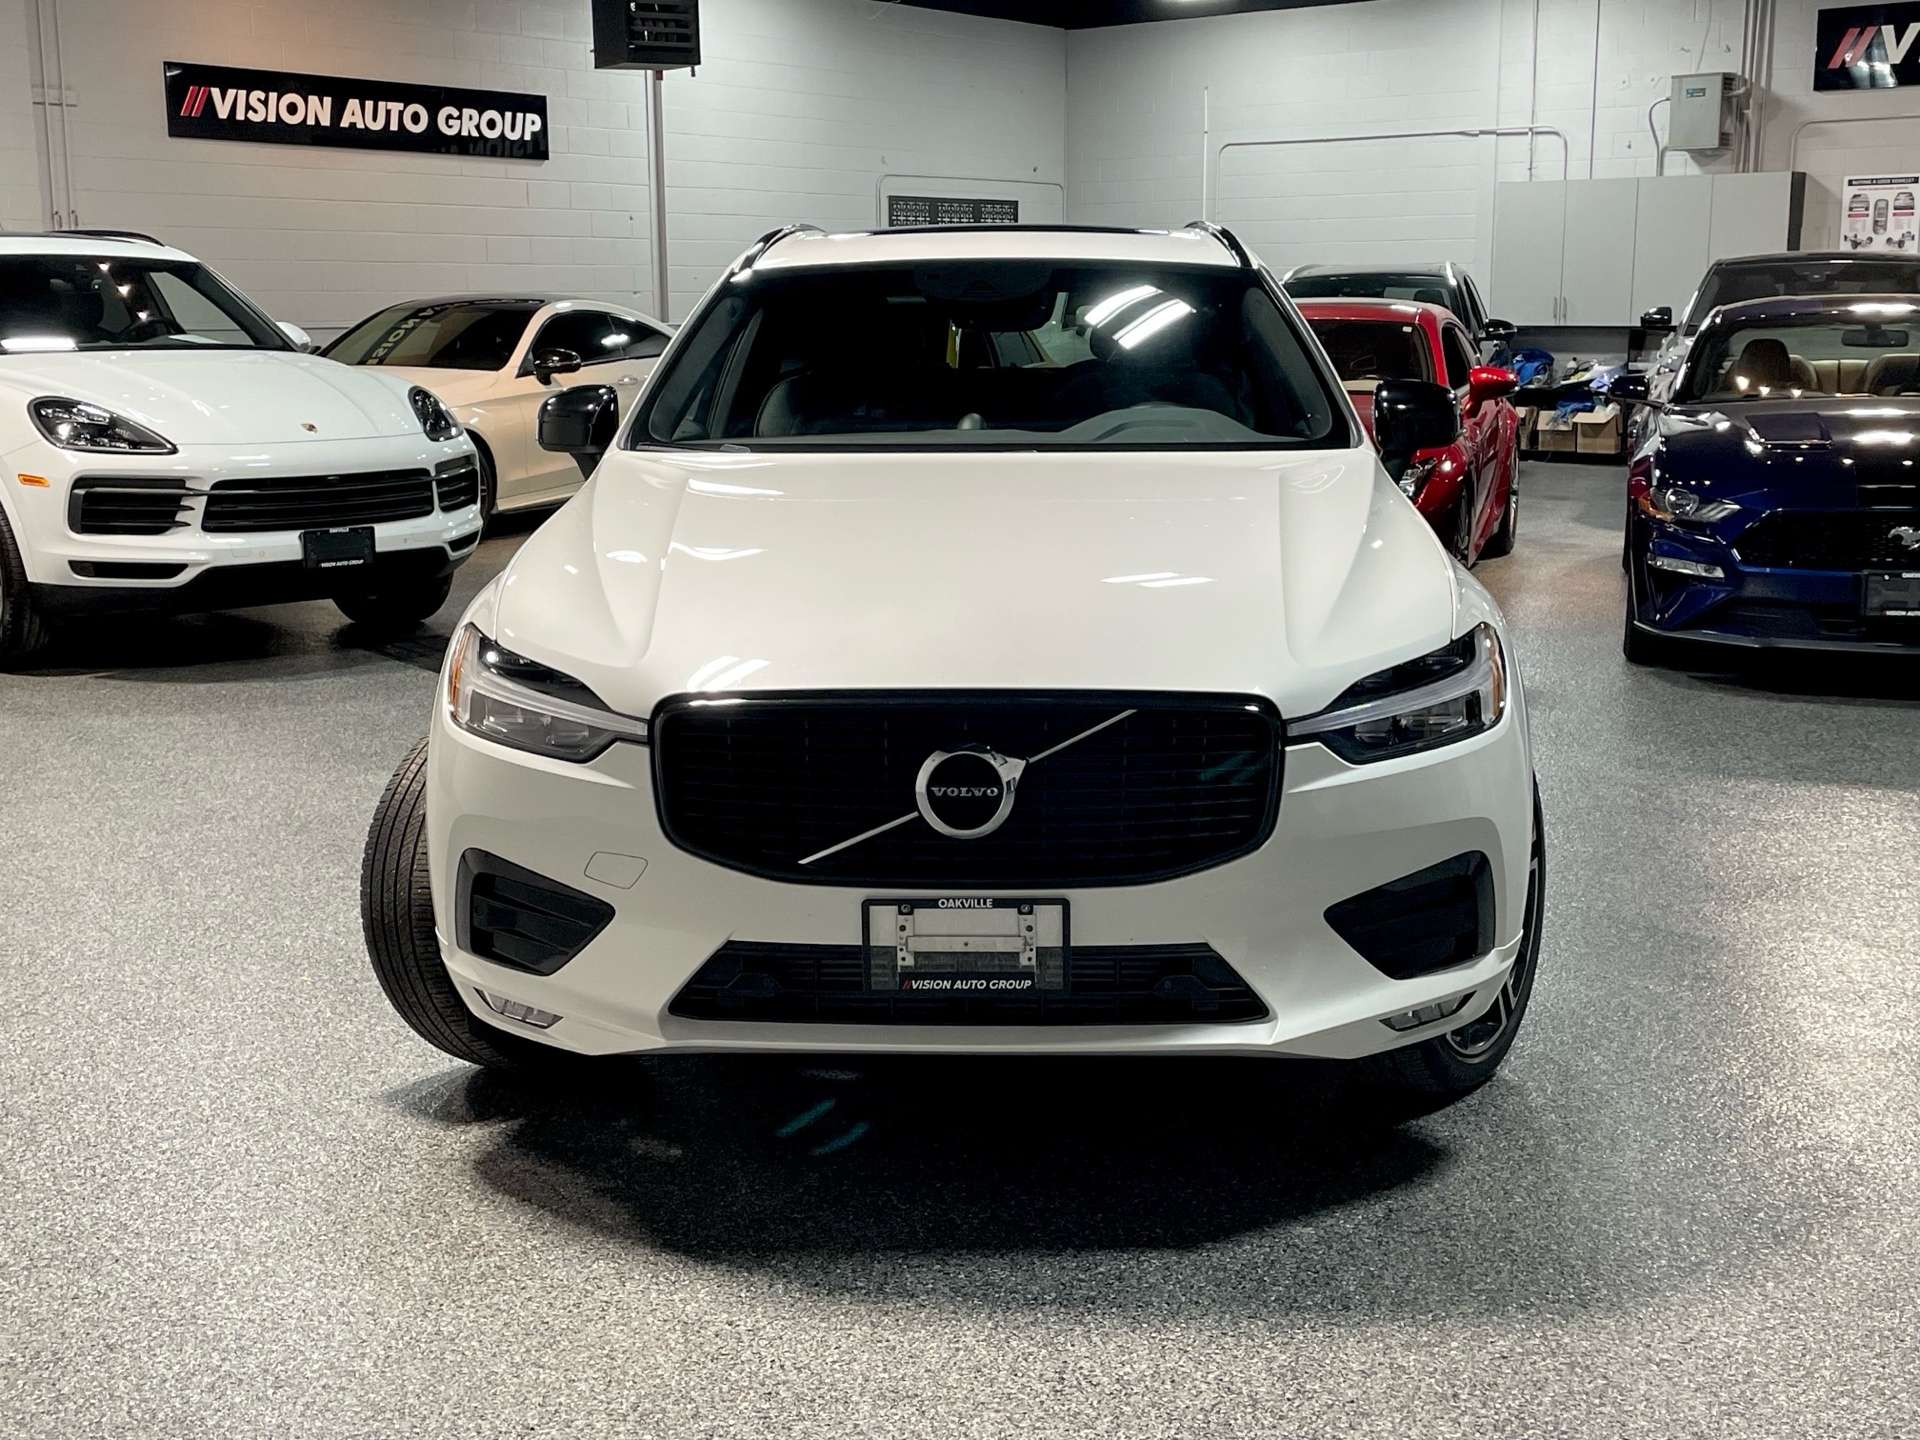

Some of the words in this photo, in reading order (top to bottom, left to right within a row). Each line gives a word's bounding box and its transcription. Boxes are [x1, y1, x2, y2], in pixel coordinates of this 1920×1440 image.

[210, 87, 332, 127] VISION
[339, 98, 429, 134] AUTO
[436, 105, 542, 141] GROUP
[930, 787, 999, 797] VOLVO
[938, 898, 993, 909] OAKVILLE
[911, 979, 952, 990] VISION
[953, 979, 987, 990] AUTO
[989, 979, 1032, 990] GROUP
